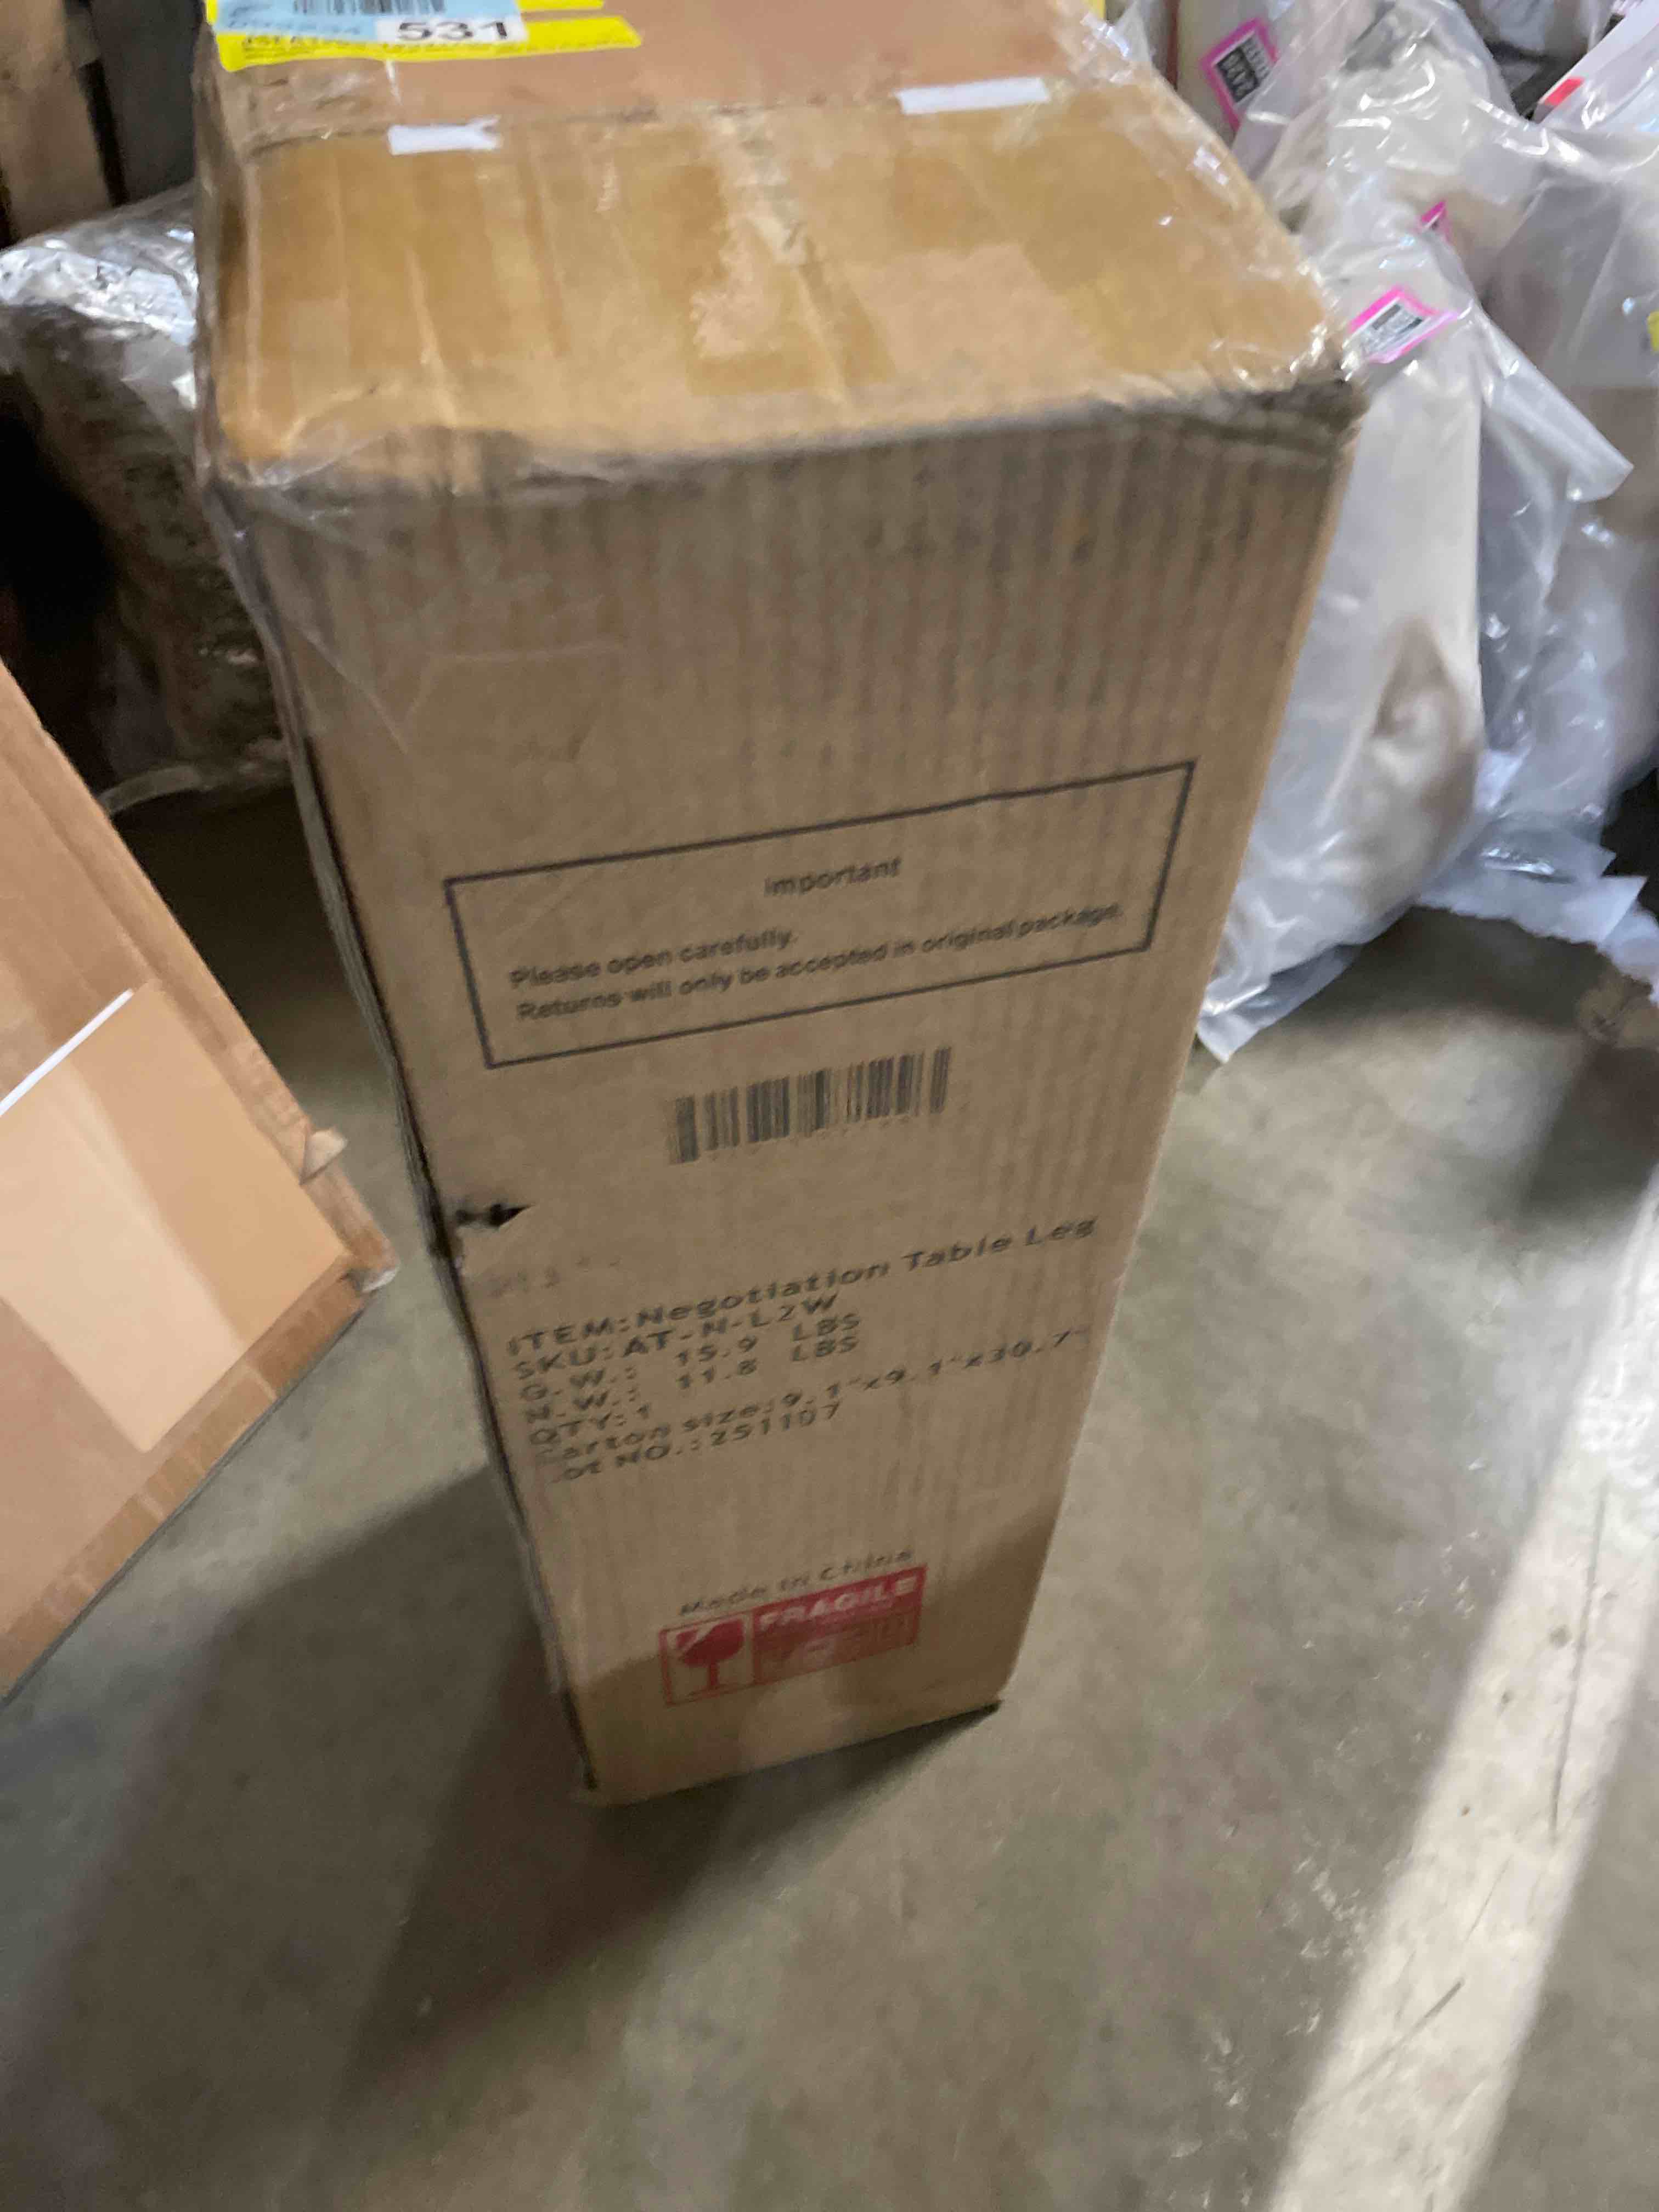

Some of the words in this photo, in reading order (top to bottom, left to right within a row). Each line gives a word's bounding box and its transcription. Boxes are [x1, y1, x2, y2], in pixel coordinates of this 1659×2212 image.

[399, 21, 509, 41] 531
[765, 856, 902, 896] Important
[509, 962, 600, 988] Please
[606, 949, 672, 974] open
[516, 992, 623, 1020] Returns
[624, 980, 672, 1002] will
[679, 972, 732, 996] only
[737, 967, 769, 985] be
[775, 944, 888, 979] accepted
[893, 939, 915, 958] in
[922, 919, 1014, 952] original
[902, 1238, 1013, 1272] Table
[1024, 1218, 1096, 1246] Leg
[792, 1313, 861, 1342] LBS
[676, 1358, 758, 1390] 11.8
[791, 1335, 858, 1363] LBS
